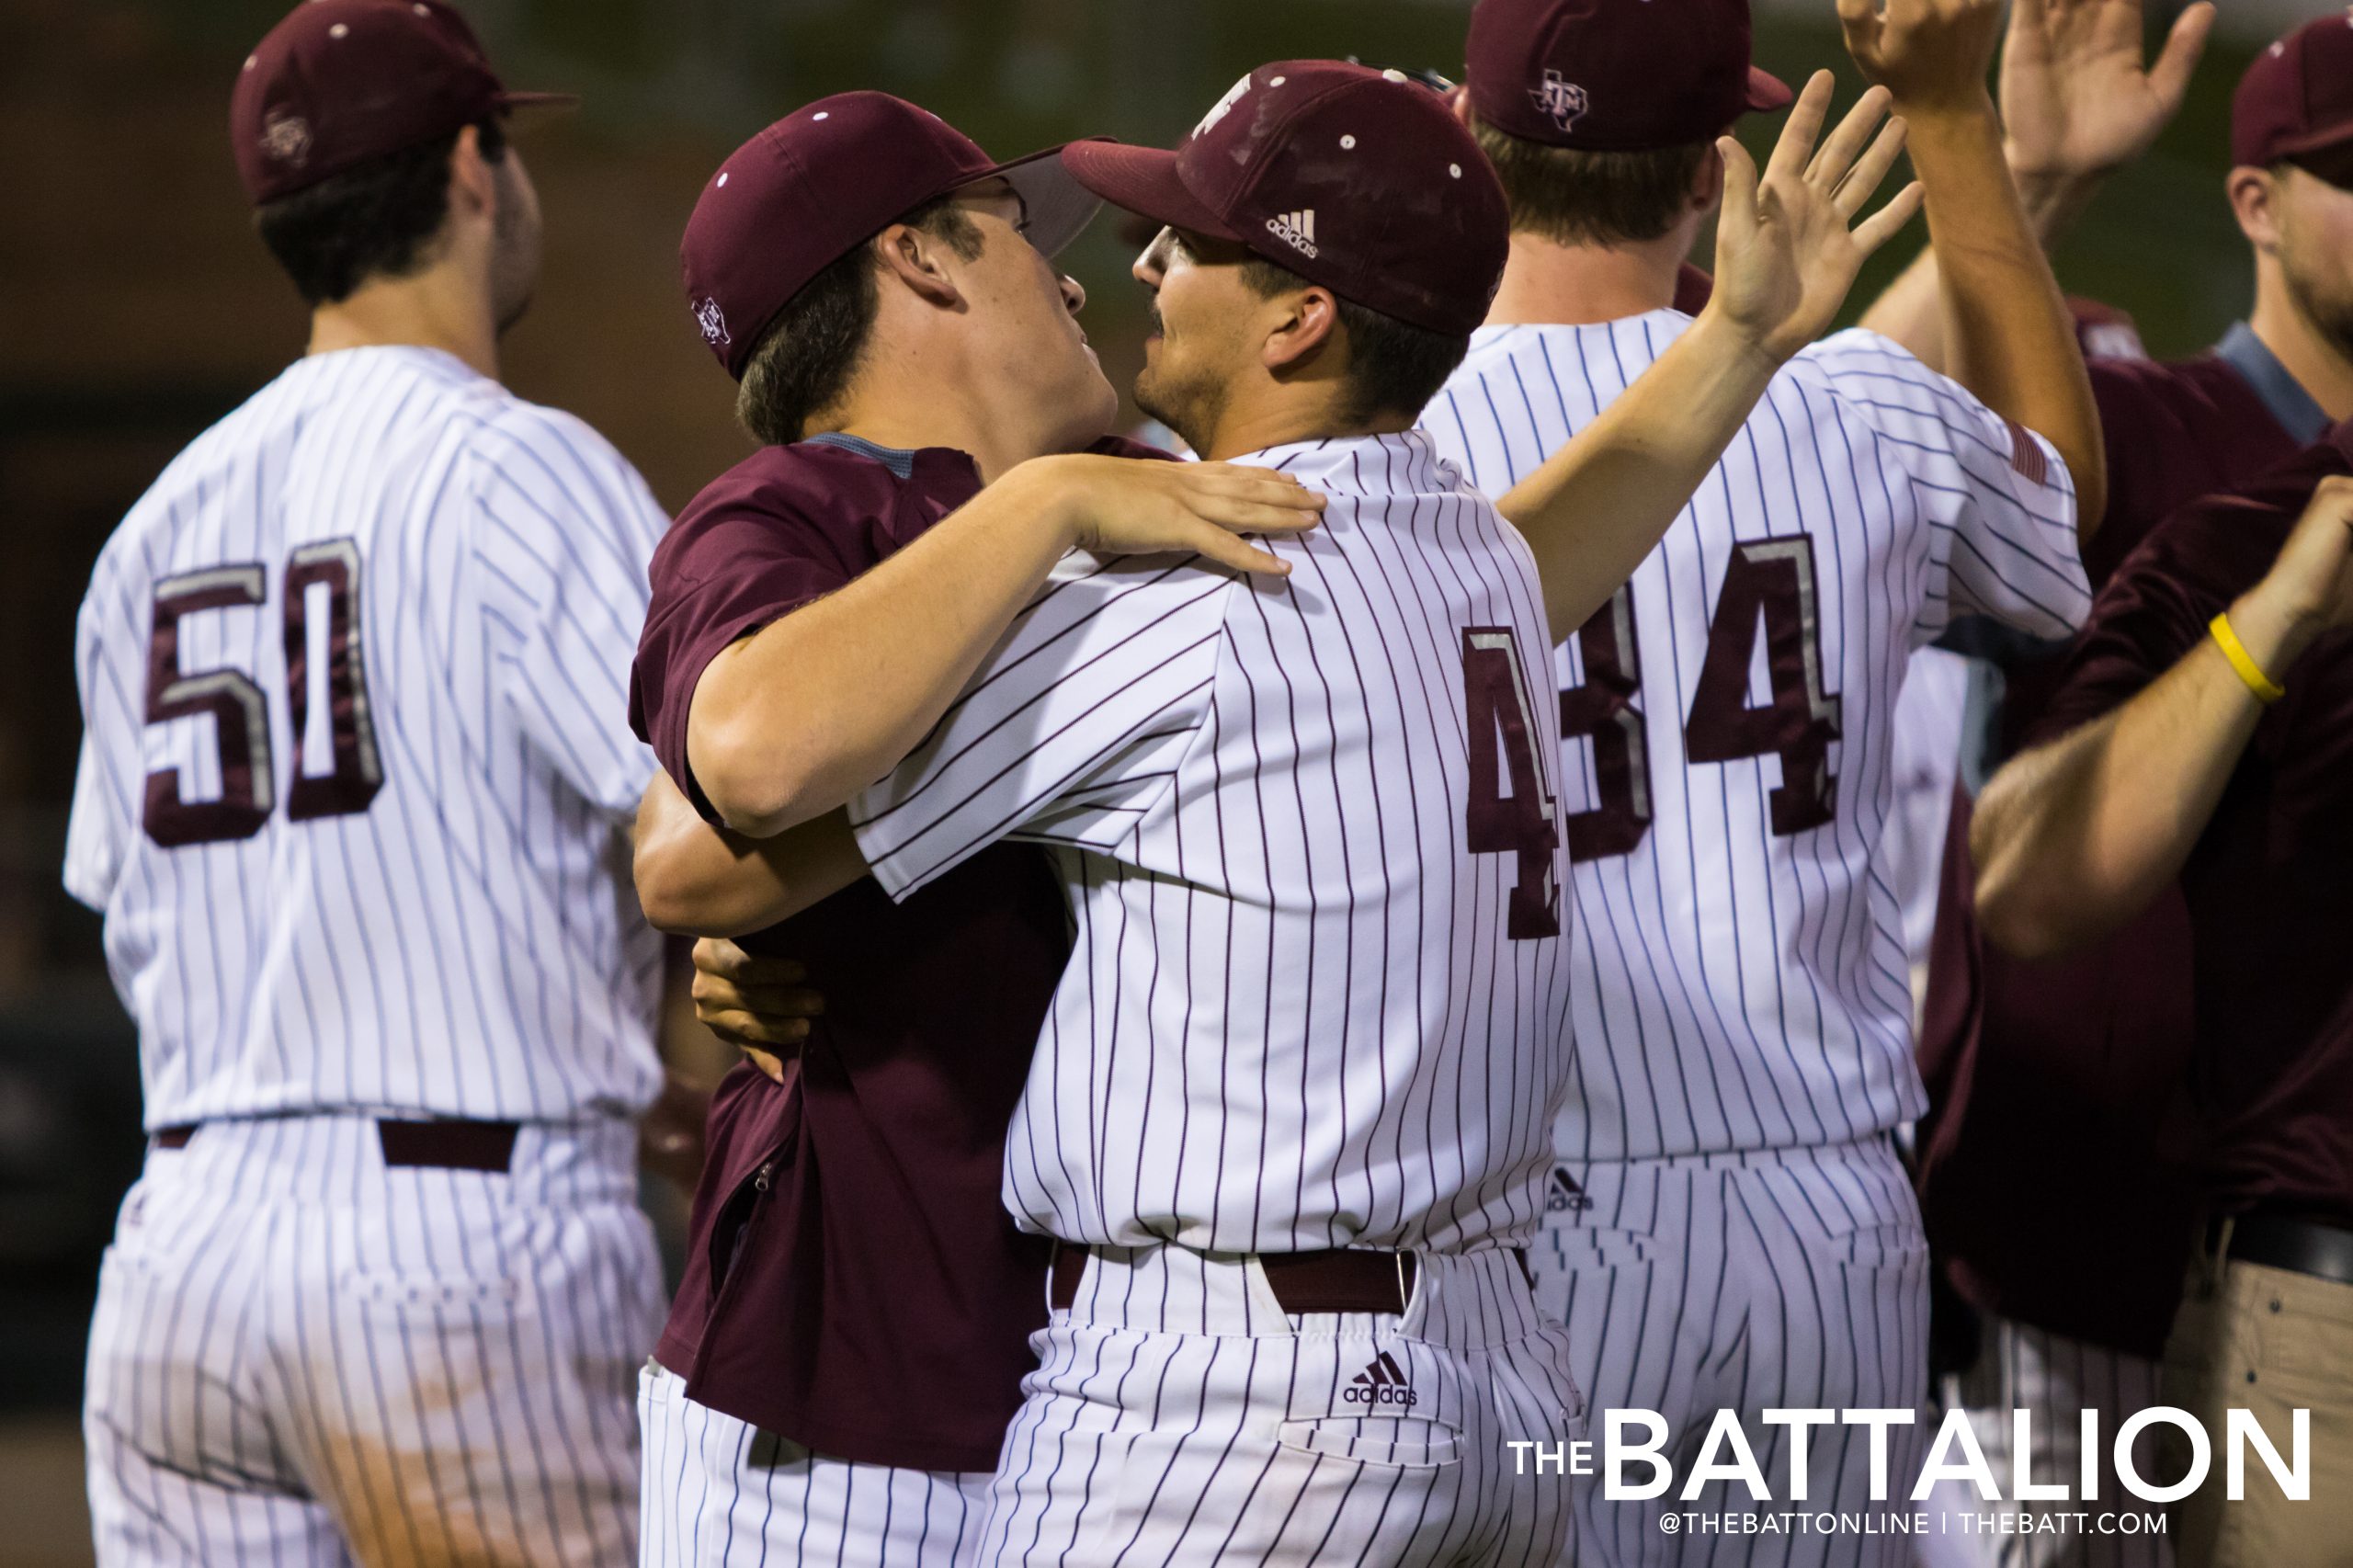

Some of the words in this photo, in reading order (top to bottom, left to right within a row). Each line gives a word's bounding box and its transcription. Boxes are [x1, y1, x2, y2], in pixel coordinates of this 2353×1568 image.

[1266, 219, 1318, 259] adidas
[142, 536, 385, 848] 50
[1461, 626, 1561, 939] 4
[1343, 1383, 1417, 1405] adidas
